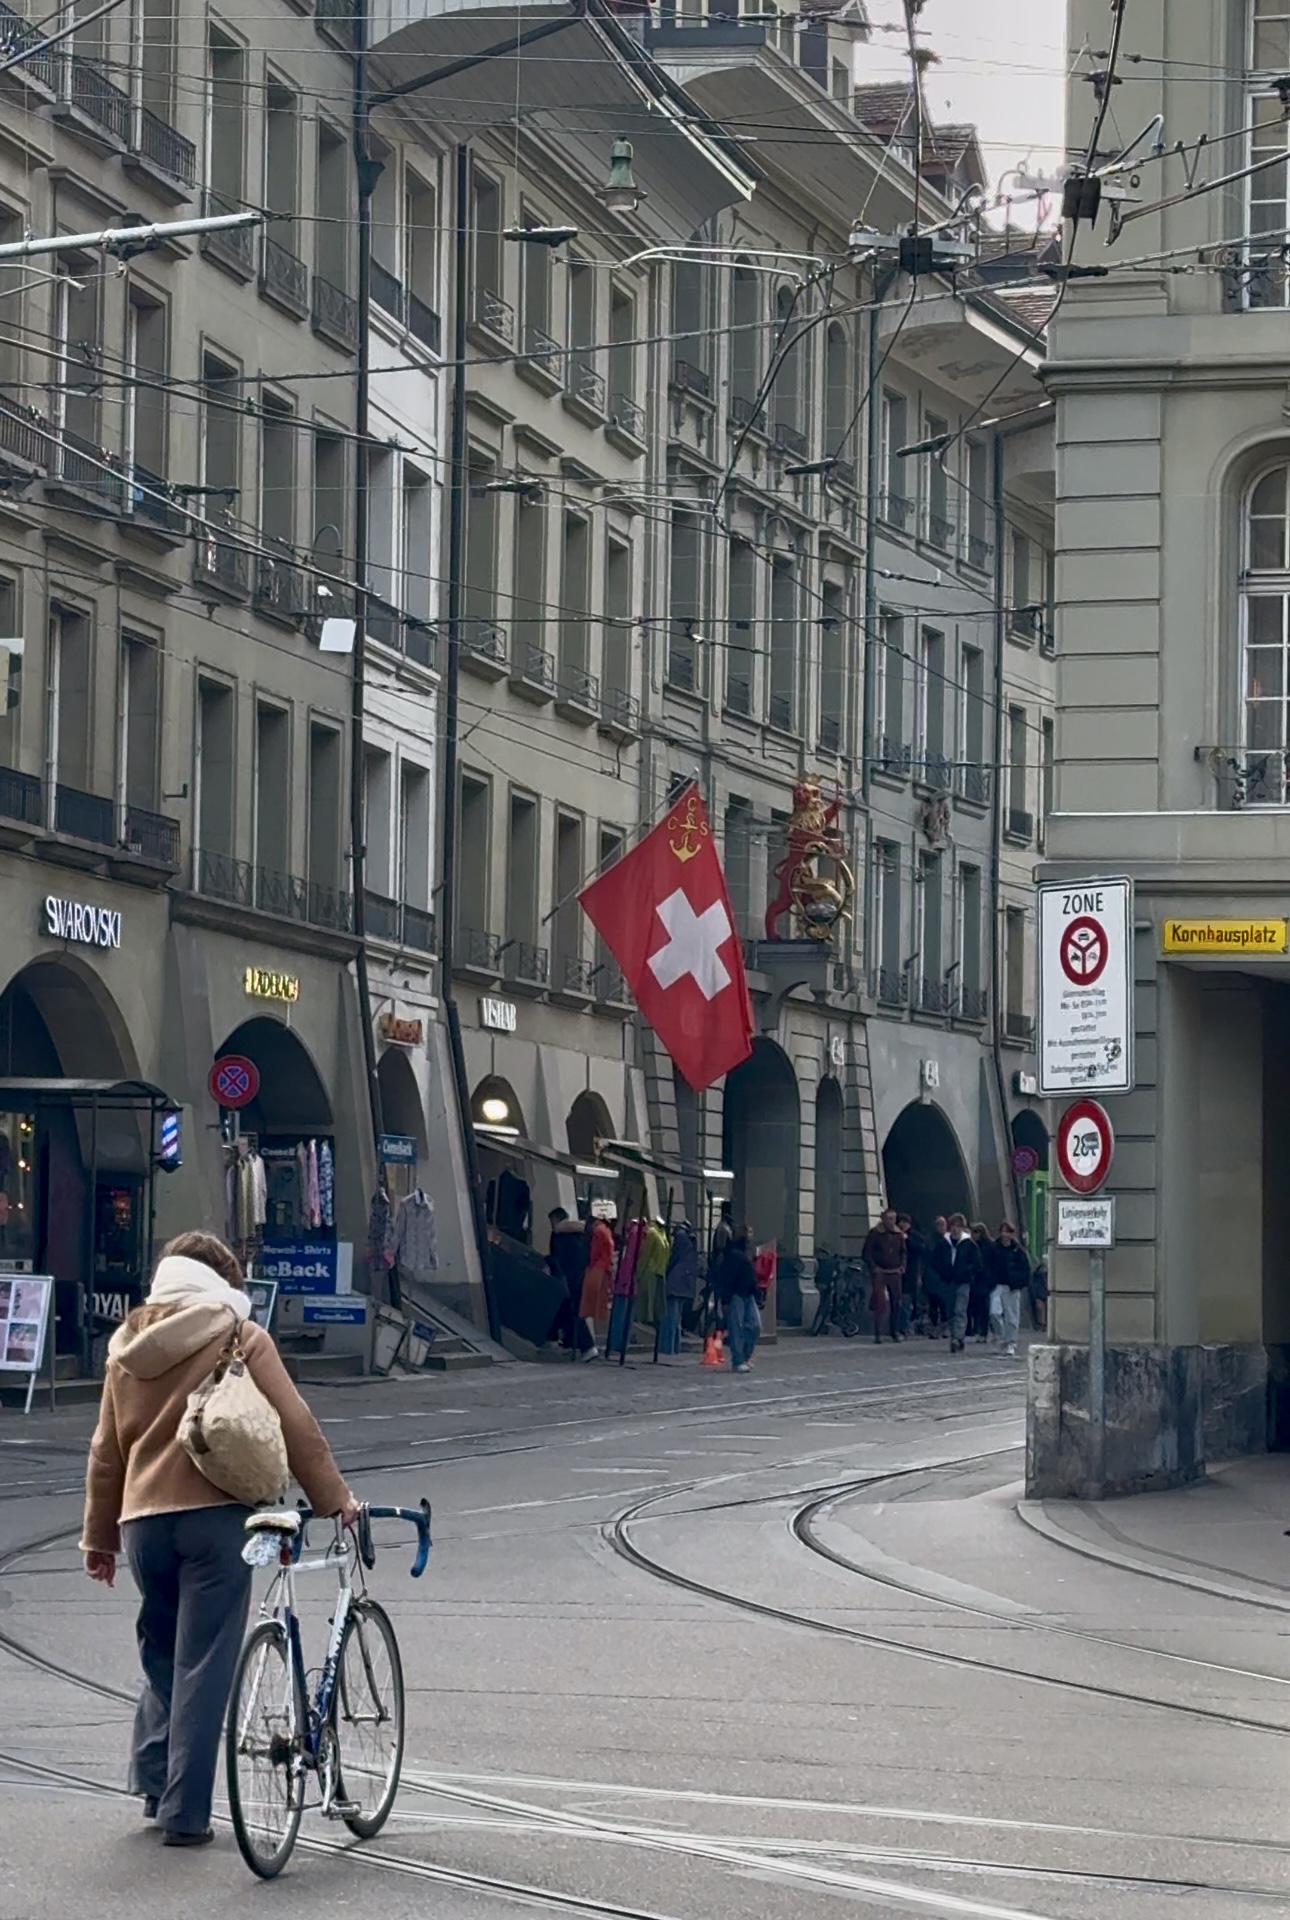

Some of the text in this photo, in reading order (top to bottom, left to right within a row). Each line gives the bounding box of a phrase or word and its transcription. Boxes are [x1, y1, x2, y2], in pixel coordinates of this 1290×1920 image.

[1062, 892, 1104, 914] ZONE
[46, 896, 121, 948] SWAROVSKI
[1172, 924, 1277, 946] Kornhausplatz
